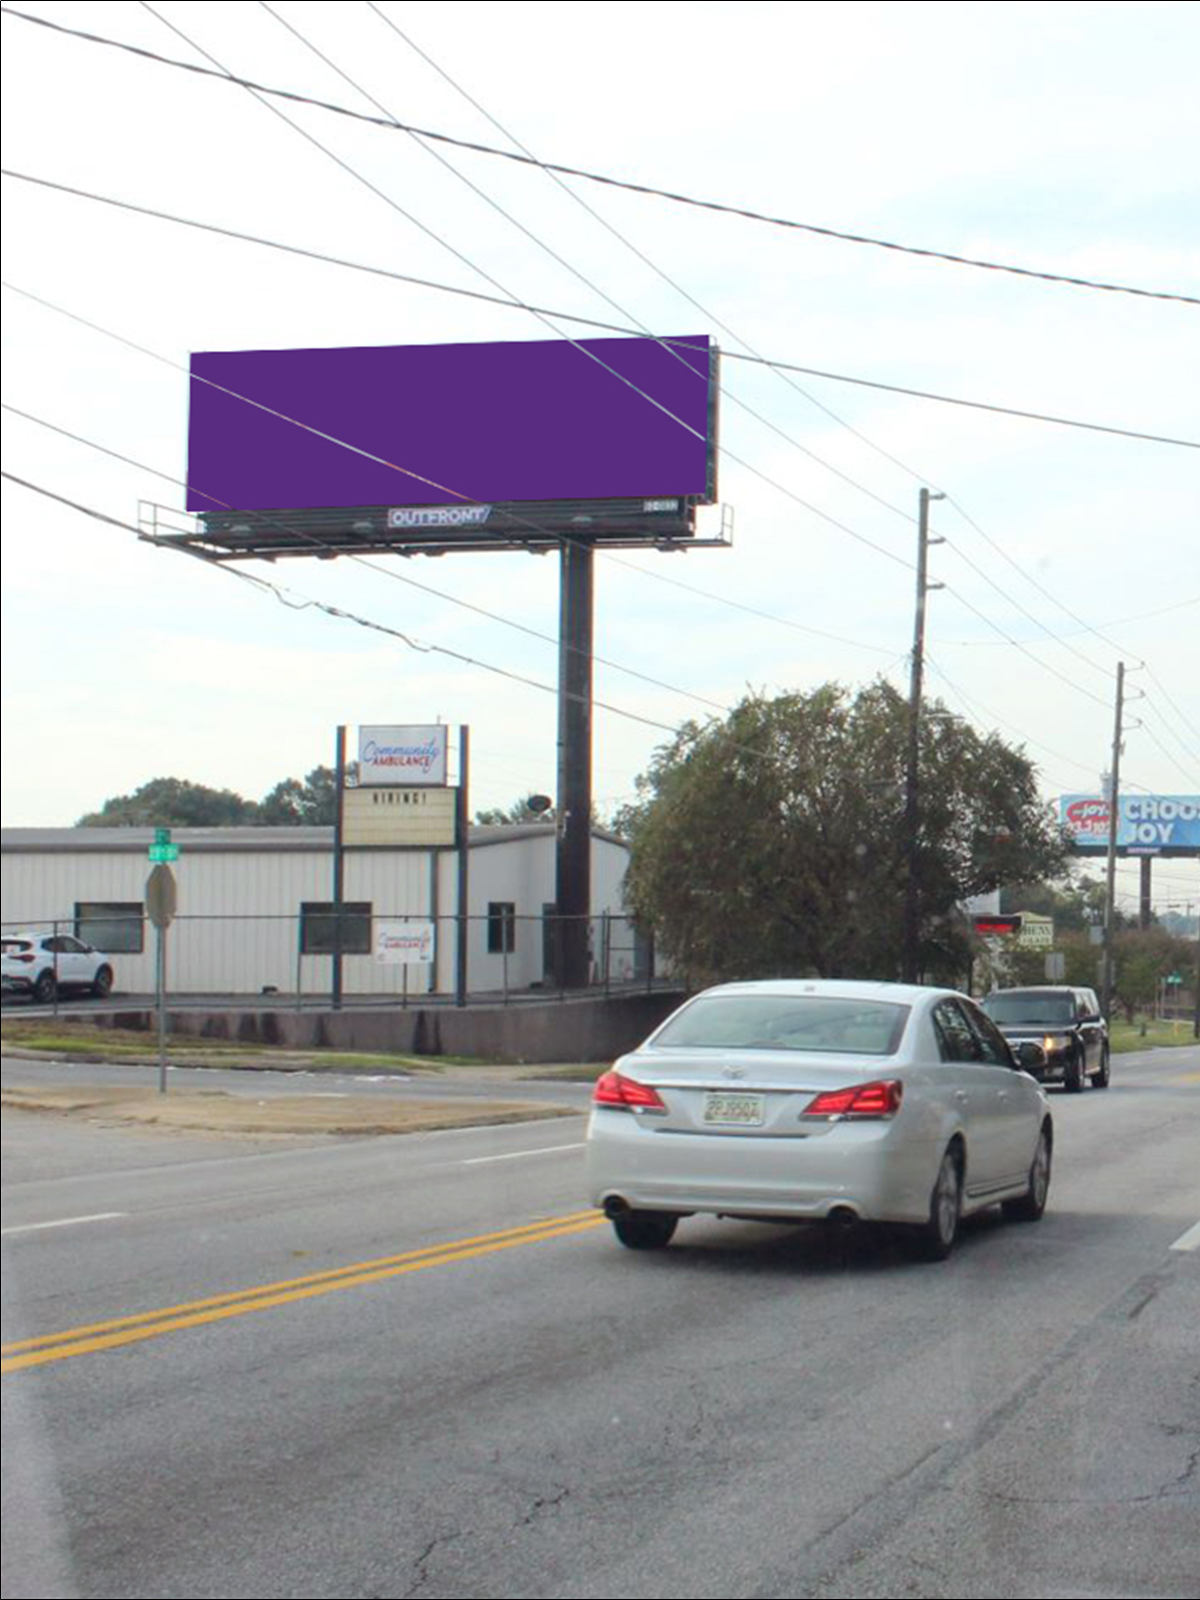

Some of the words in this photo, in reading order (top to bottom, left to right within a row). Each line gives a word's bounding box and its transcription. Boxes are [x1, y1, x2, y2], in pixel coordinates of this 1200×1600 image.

[392, 506, 485, 525] OUTFRONT
[363, 737, 440, 774] Community
[373, 757, 430, 767] AMBULANCE
[1125, 823, 1176, 843] JOY
